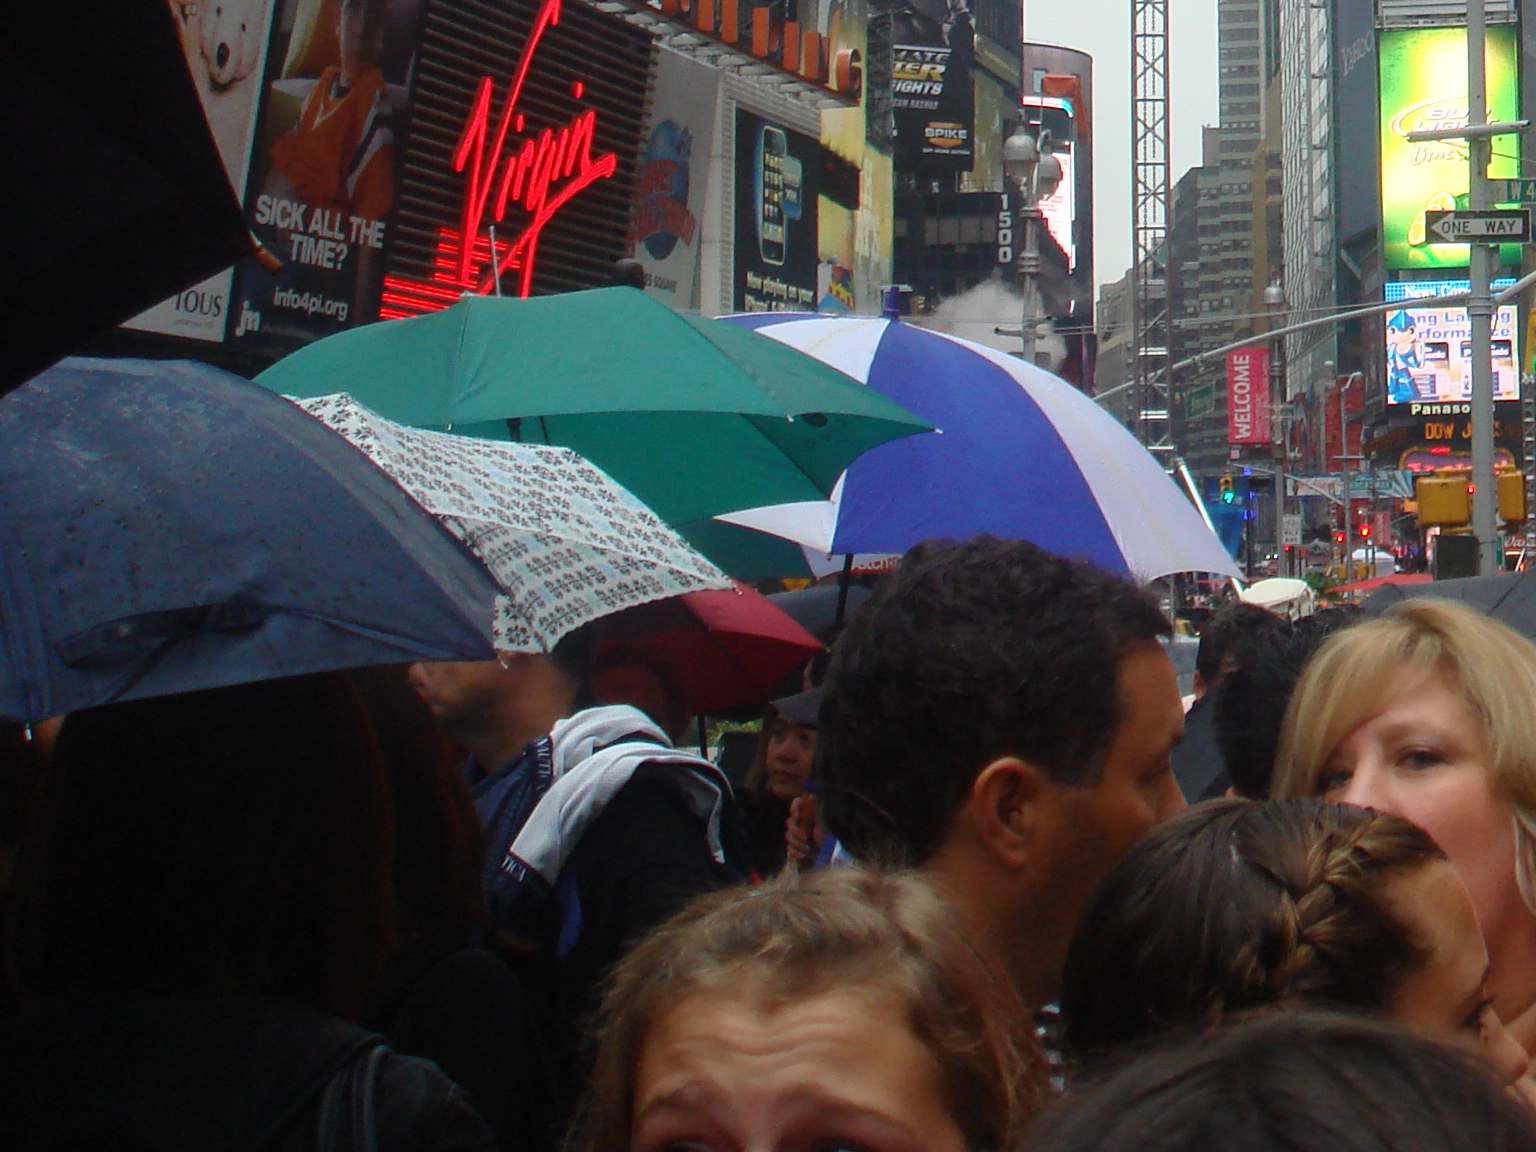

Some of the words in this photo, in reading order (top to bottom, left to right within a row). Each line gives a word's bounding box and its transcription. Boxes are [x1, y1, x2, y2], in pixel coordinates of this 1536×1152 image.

[924, 127, 968, 140] SPIKE
[1411, 146, 1455, 166] Lime
[1510, 183, 1522, 199] W
[255, 194, 307, 232] SICK
[308, 208, 346, 240] ALL
[349, 216, 387, 248] THE
[998, 194, 1013, 264] 1500
[1442, 221, 1470, 234] ONE
[1485, 220, 1516, 233] WAY
[290, 233, 349, 271] TIME?
[274, 286, 349, 321] info4pi.org
[1233, 354, 1250, 440] WELCOME
[1424, 422, 1455, 439] DOW
